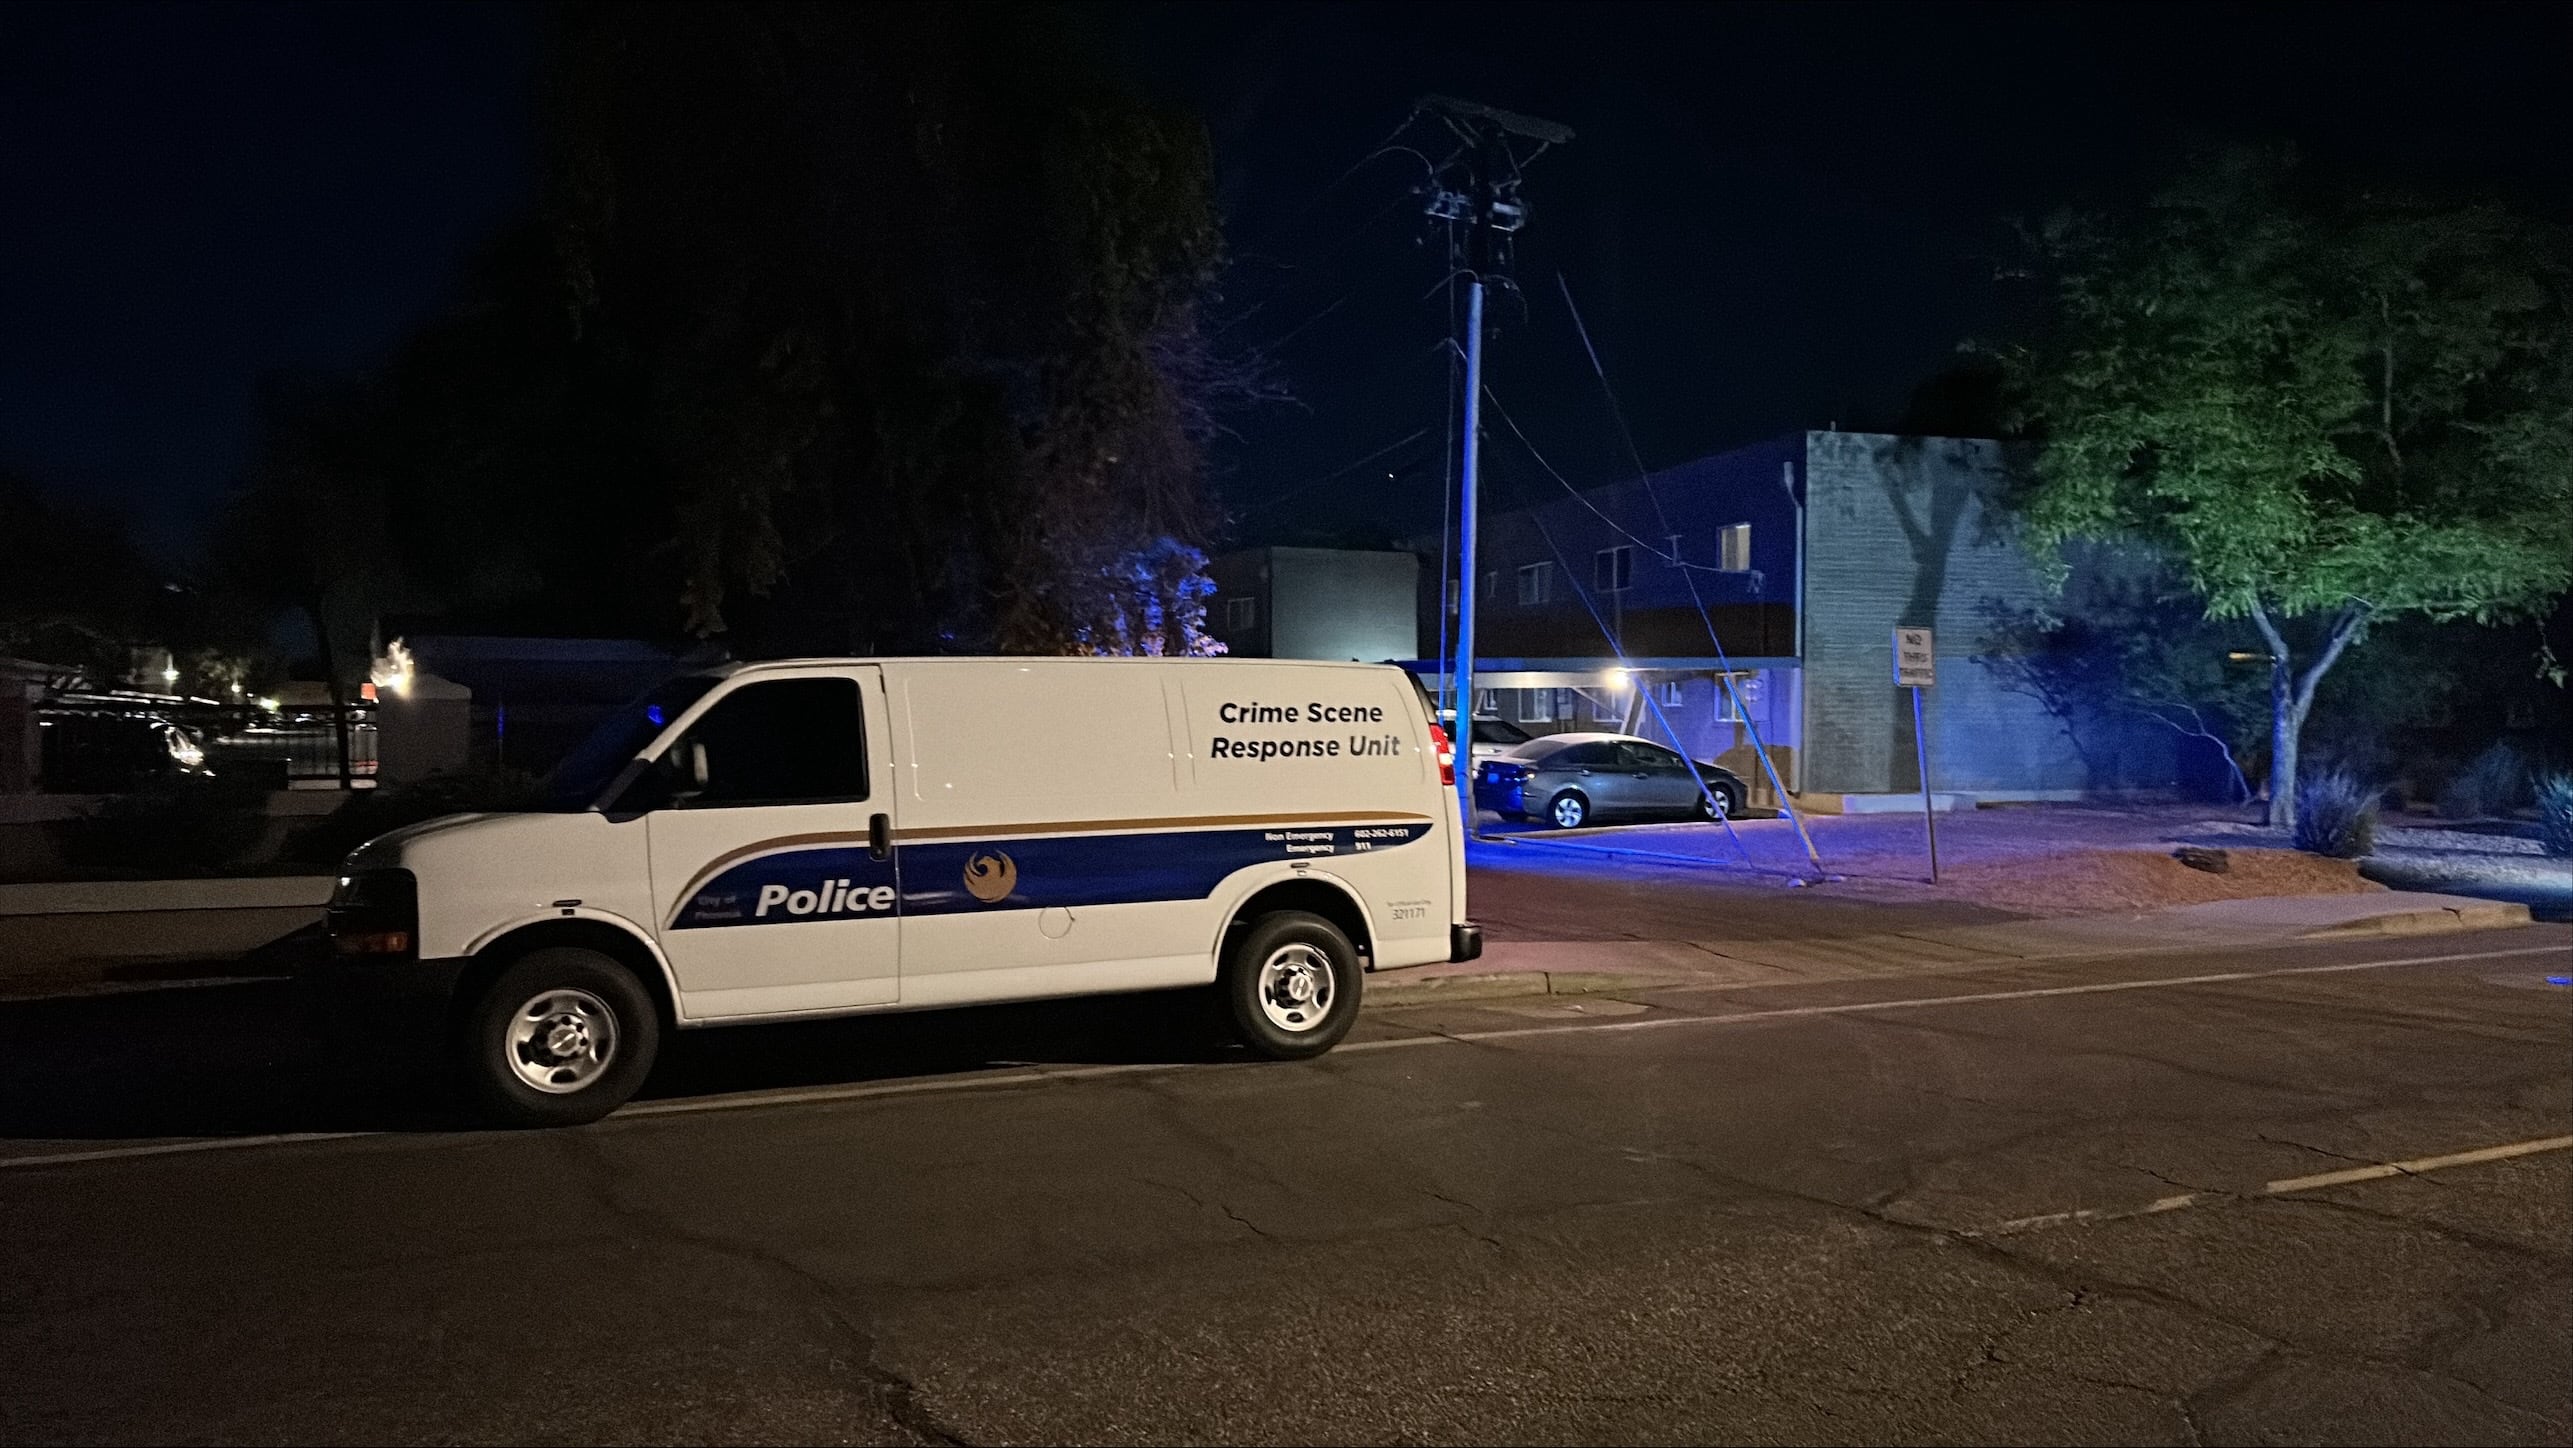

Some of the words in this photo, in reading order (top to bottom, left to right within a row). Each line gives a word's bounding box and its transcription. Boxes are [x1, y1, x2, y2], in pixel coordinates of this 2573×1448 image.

[1906, 634, 1922, 646] NO
[1219, 702, 1299, 723] Crime
[1307, 702, 1383, 723] Scene
[1211, 737, 1340, 762] Response
[1350, 735, 1400, 756] Unit
[1265, 832, 1285, 841] Non
[1285, 832, 1334, 841] Emergency
[1286, 844, 1335, 853] Emergency
[1355, 842, 1372, 851] 911
[755, 879, 896, 917] Police
